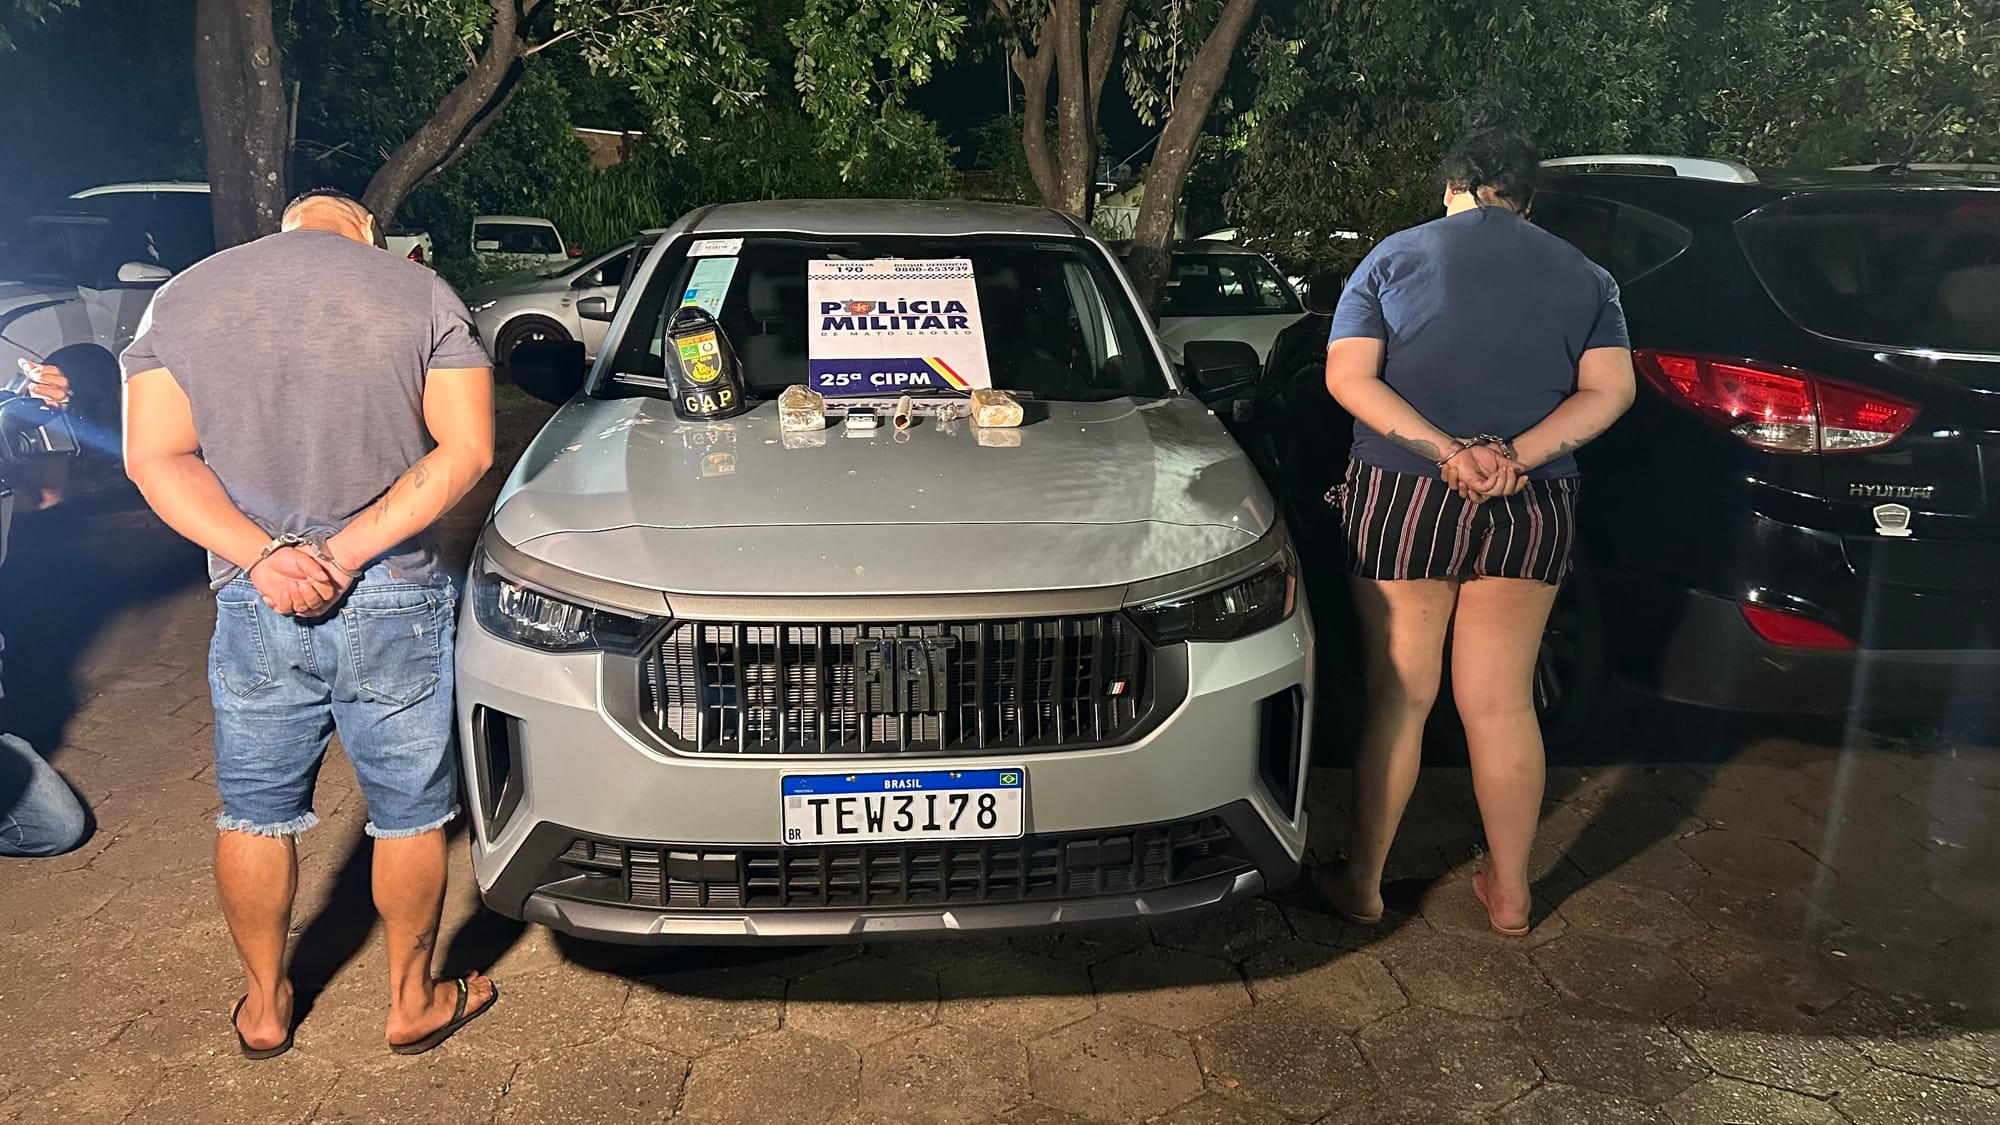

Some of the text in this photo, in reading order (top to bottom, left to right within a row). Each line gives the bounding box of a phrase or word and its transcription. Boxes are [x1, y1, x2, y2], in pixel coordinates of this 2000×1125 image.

[822, 315, 970, 330] MILITAR
[870, 372, 931, 386] CIPM
[685, 389, 732, 413] GAP
[1850, 483, 1935, 499] HYUNDAI
[854, 637, 957, 713] FIAT
[884, 778, 922, 789] BRASIL
[807, 793, 997, 835] TEW3I78
[788, 828, 802, 840] BR
